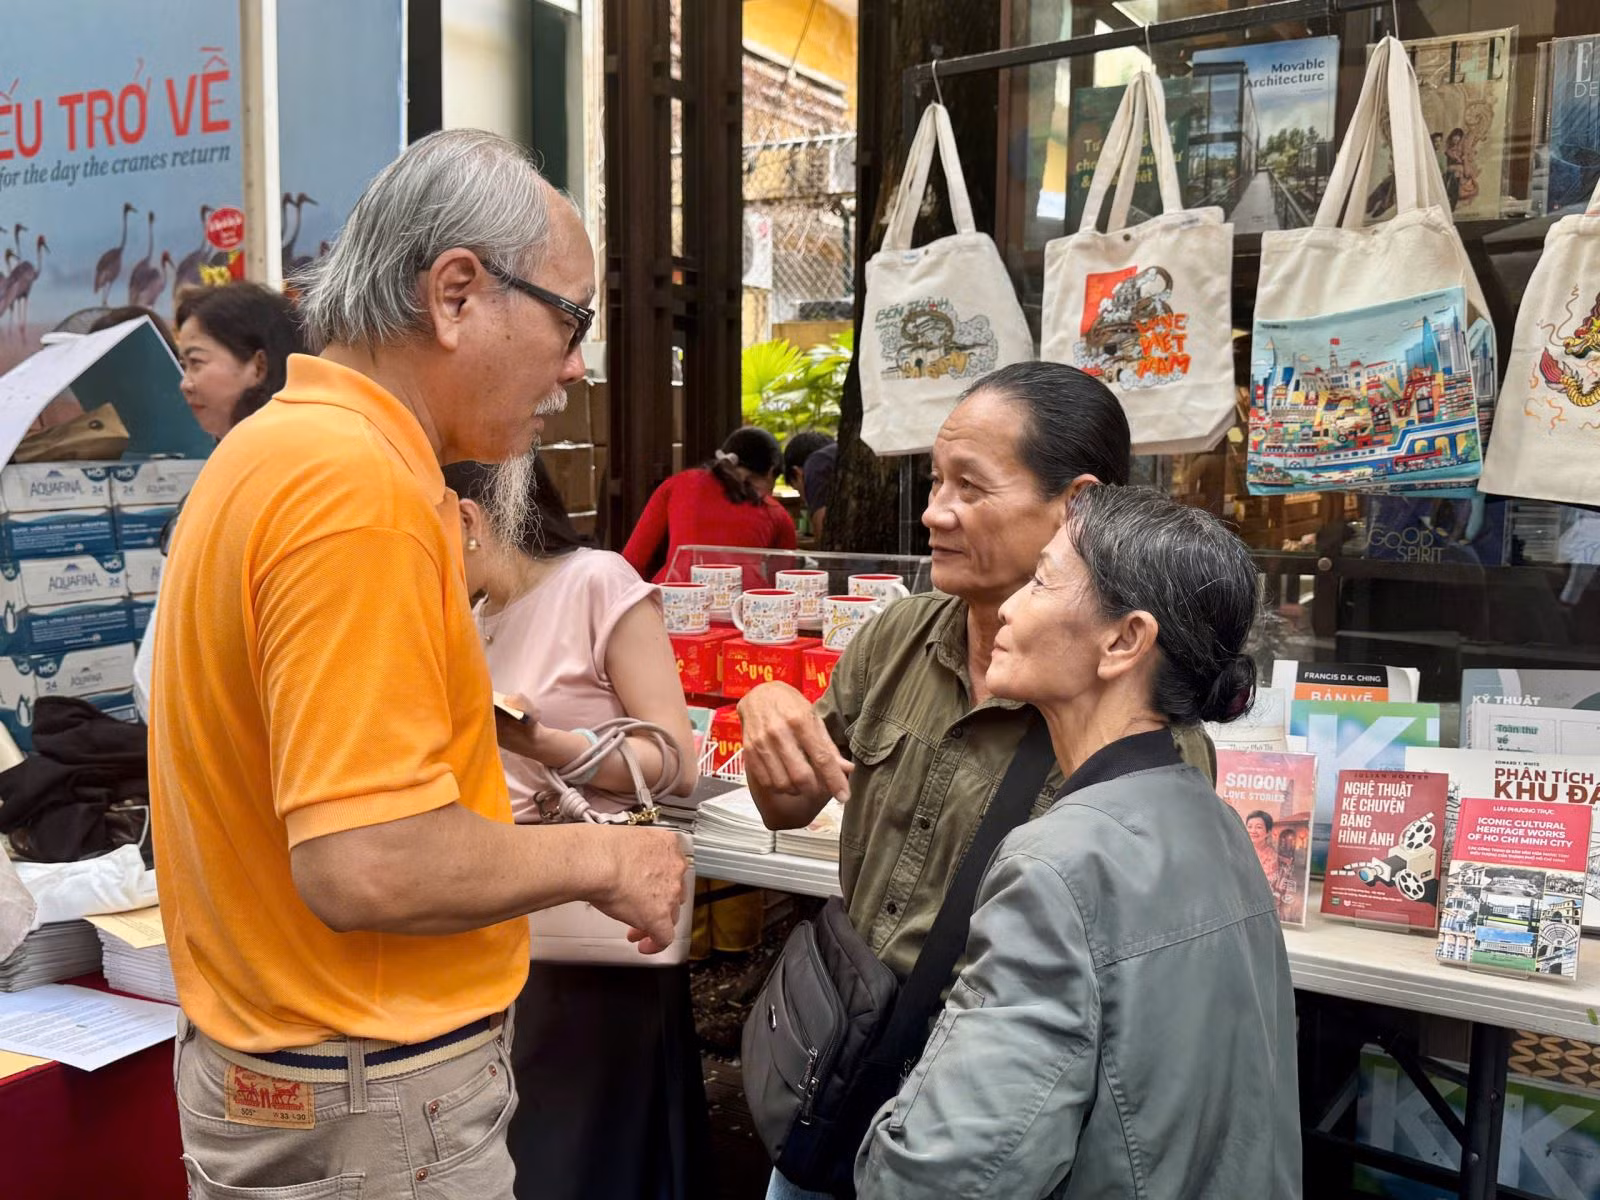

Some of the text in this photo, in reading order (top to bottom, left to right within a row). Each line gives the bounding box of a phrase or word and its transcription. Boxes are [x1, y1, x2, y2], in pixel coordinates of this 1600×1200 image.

[1270, 58, 1326, 74] Movable
[1244, 72, 1326, 89] Architecture
[58, 57, 152, 152] TRỞ
[165, 46, 231, 137] VỀ
[23, 163, 47, 185] the
[51, 160, 80, 186] day
[82, 155, 108, 178] the
[111, 152, 167, 176] cranes
[171, 145, 231, 168] return
[30, 480, 82, 497] AQUAFINA
[92, 485, 104, 494] 24
[1368, 527, 1434, 549] GOOD
[1398, 546, 1446, 563] SPIRIT
[48, 573, 100, 592] AQUAFINA
[108, 577, 121, 588] 24
[735, 660, 774, 682] TRUNG
[1304, 671, 1339, 681] FRANCIS
[1357, 674, 1381, 683] CHING
[46, 682, 58, 690] 24
[1495, 724, 1520, 734] Toàn
[1225, 772, 1288, 792] SAIGON
[1494, 767, 1594, 785] PHÂN TÍCH
[1223, 790, 1286, 803] LOVE STORIES
[1344, 780, 1414, 800] NGHỆ THUẬT
[1494, 780, 1559, 803] KHU
[1359, 797, 1405, 815] CHUYỆN
[1476, 825, 1566, 839] HERITAGE WORKS
[1478, 817, 1566, 831] ICONIC CULTURAL
[1338, 828, 1366, 845] HÌNH
[1500, 836, 1519, 844] CHI
[1520, 838, 1548, 846] MINH
[1549, 840, 1573, 848] CITY
[280, 1112, 289, 1120] 33
